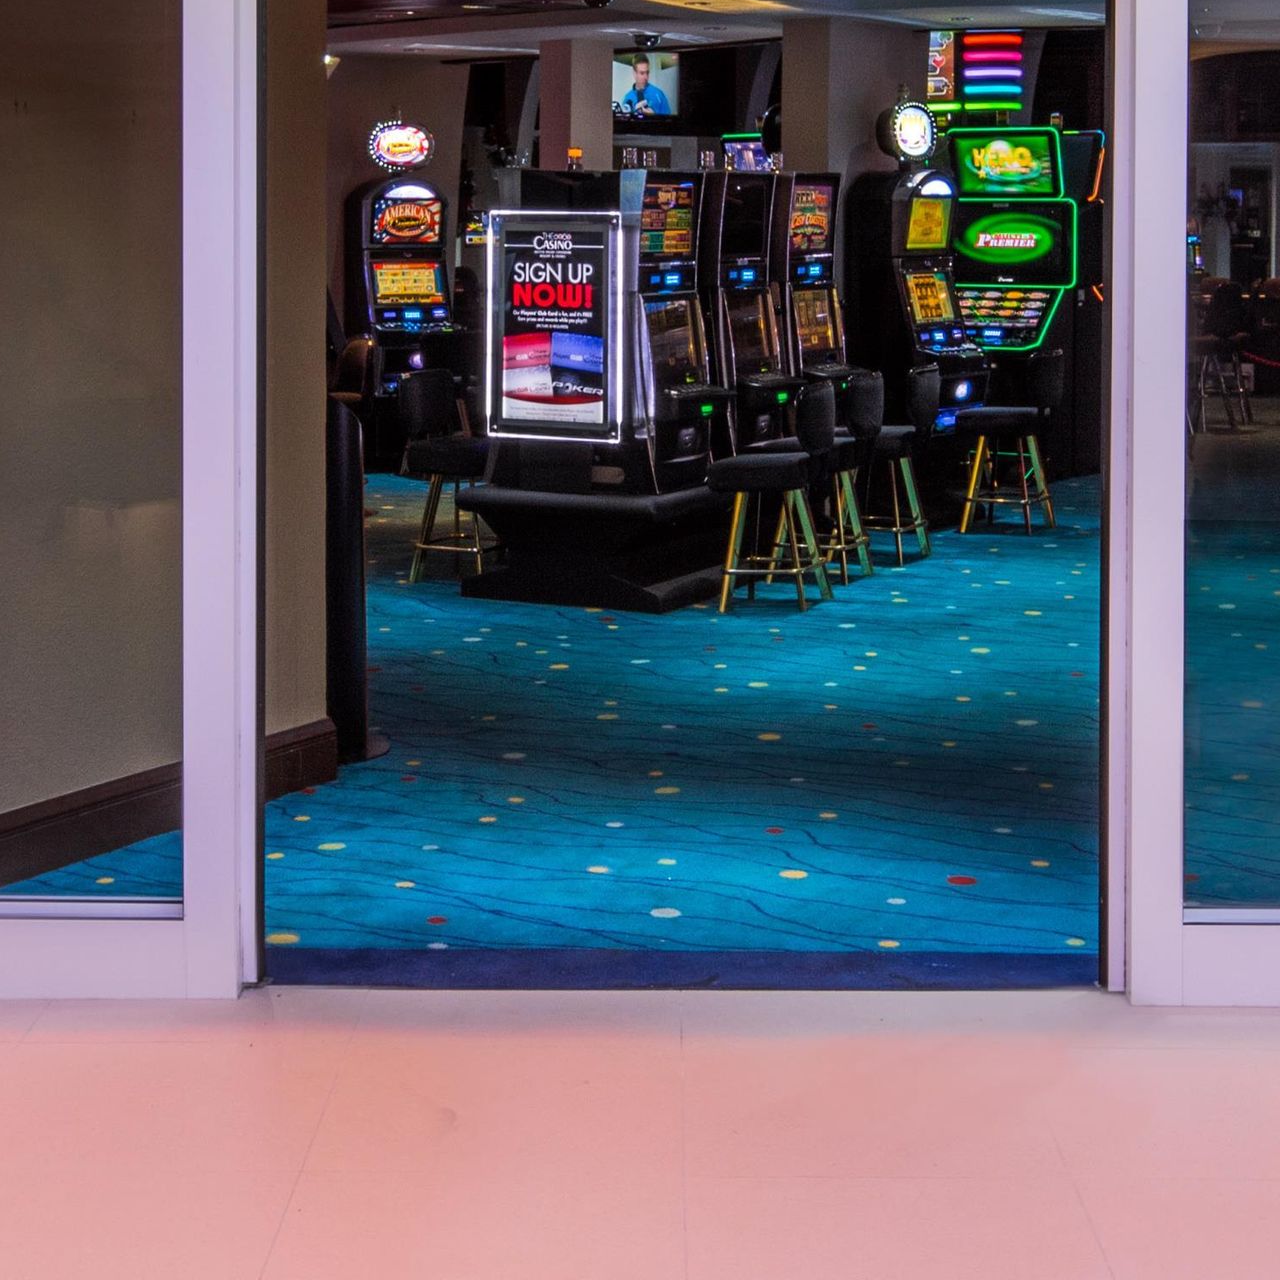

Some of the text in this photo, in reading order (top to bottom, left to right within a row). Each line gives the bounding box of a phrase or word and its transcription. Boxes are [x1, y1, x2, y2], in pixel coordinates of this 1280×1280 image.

[384, 204, 431, 224] AMERICAN
[534, 236, 572, 250] CASINO
[974, 233, 1036, 248] PREMIER
[514, 262, 593, 283] SIGN UP
[513, 283, 593, 308] NOW!
[552, 381, 604, 396] POKER
